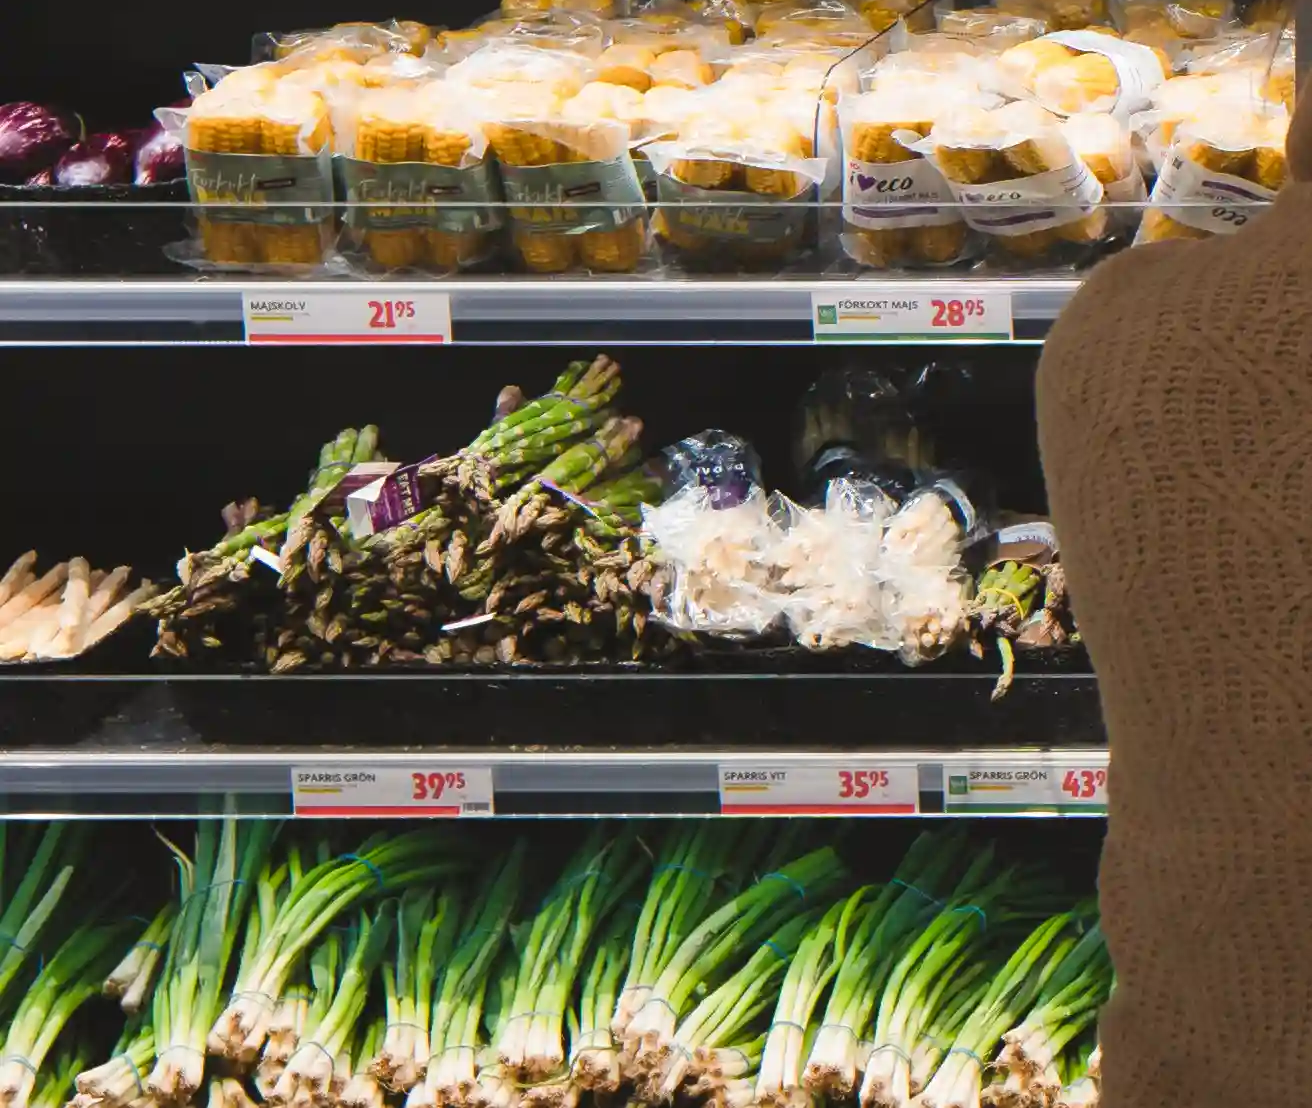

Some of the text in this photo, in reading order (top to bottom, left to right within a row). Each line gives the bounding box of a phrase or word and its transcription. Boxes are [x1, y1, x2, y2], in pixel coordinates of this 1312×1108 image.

[876, 176, 914, 193] eco
[250, 301, 306, 312] MAJSKOLV
[892, 301, 918, 310] MAJS
[298, 772, 376, 782] SPARRIS GRÖN
[724, 772, 786, 781] SPARRIS VIT
[969, 770, 1047, 780] SPARRIS GRÖN
